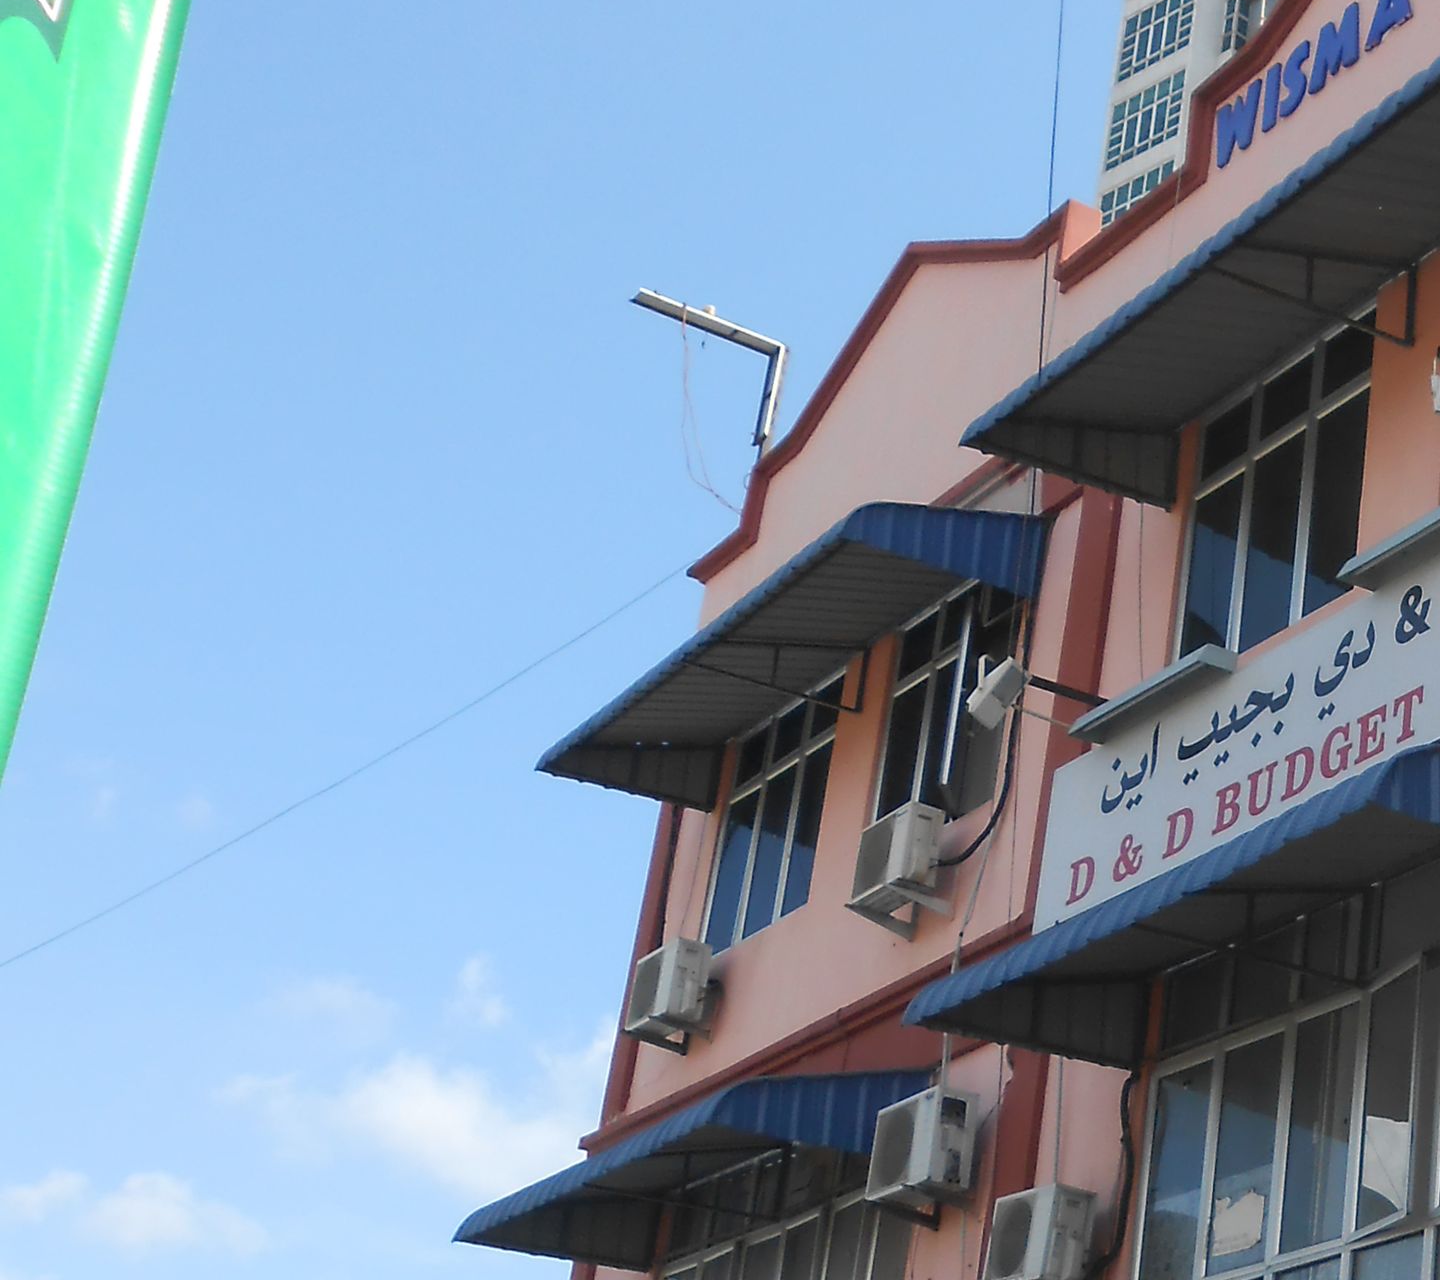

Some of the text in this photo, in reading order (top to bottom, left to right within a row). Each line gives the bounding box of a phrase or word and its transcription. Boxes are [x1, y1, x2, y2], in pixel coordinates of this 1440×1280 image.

[1395, 585, 1431, 644] &
[1314, 620, 1375, 720] دي
[1065, 856, 1095, 906] D
[1112, 834, 1143, 882] &
[1162, 807, 1194, 859] D
[1211, 685, 1424, 835] BUDGET
[1101, 721, 1160, 813] اين
